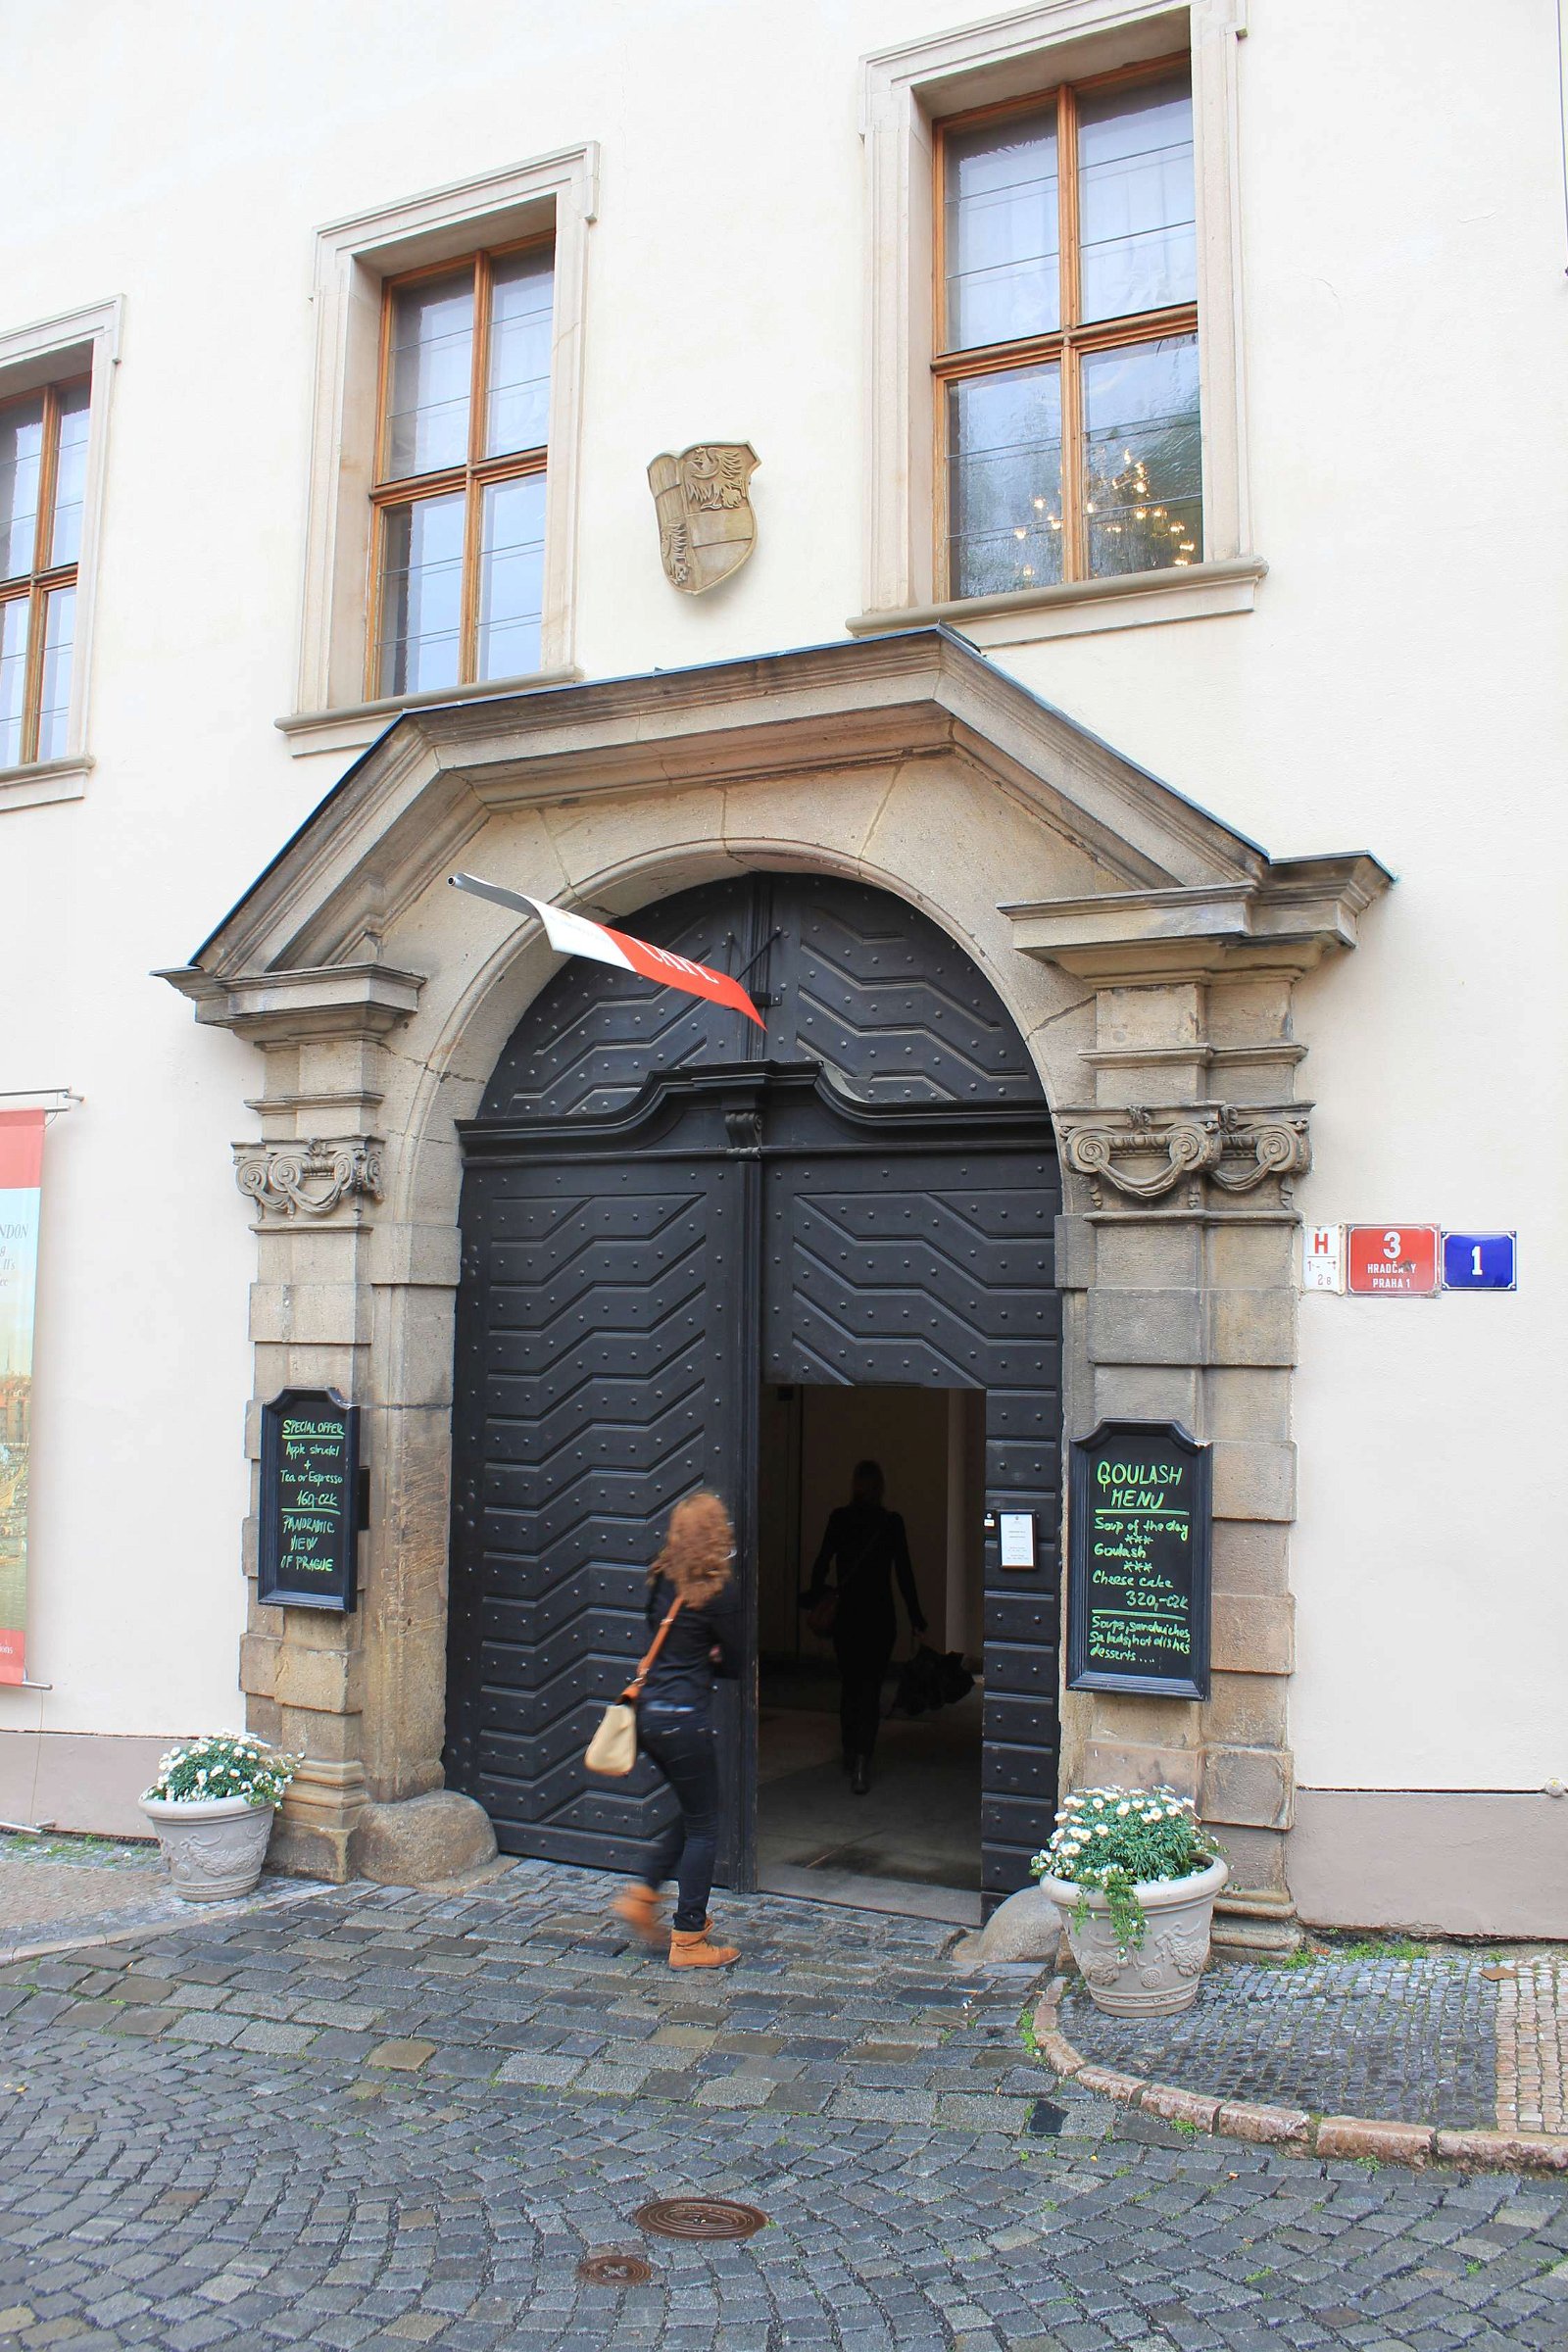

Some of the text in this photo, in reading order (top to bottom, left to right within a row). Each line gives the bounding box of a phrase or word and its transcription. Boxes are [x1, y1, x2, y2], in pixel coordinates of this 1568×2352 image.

[1314, 1233, 1329, 1254] H
[1383, 1231, 1401, 1259] 3
[1367, 1260, 1417, 1274] HRADČAY
[1472, 1246, 1484, 1276] 1
[1372, 1278, 1410, 1289] PRAHA 1
[282, 1419, 345, 1436] SPECIAL OFFER
[285, 1441, 340, 1460] Apple strudel
[280, 1469, 296, 1483] Tea
[308, 1470, 343, 1487] Espresso
[1098, 1460, 1183, 1494] GOULASH
[1110, 1489, 1164, 1509] MENU
[282, 1514, 335, 1534] PANORAMIC
[1095, 1516, 1189, 1542] Soup of the day
[290, 1535, 318, 1551] VIEW
[1094, 1543, 1147, 1559] Goulash
[280, 1555, 334, 1572] OF PRAGUE
[1092, 1569, 1173, 1589] Cheese cake
[1132, 1634, 1152, 1646] hot
[1153, 1635, 1191, 1654] dishes
